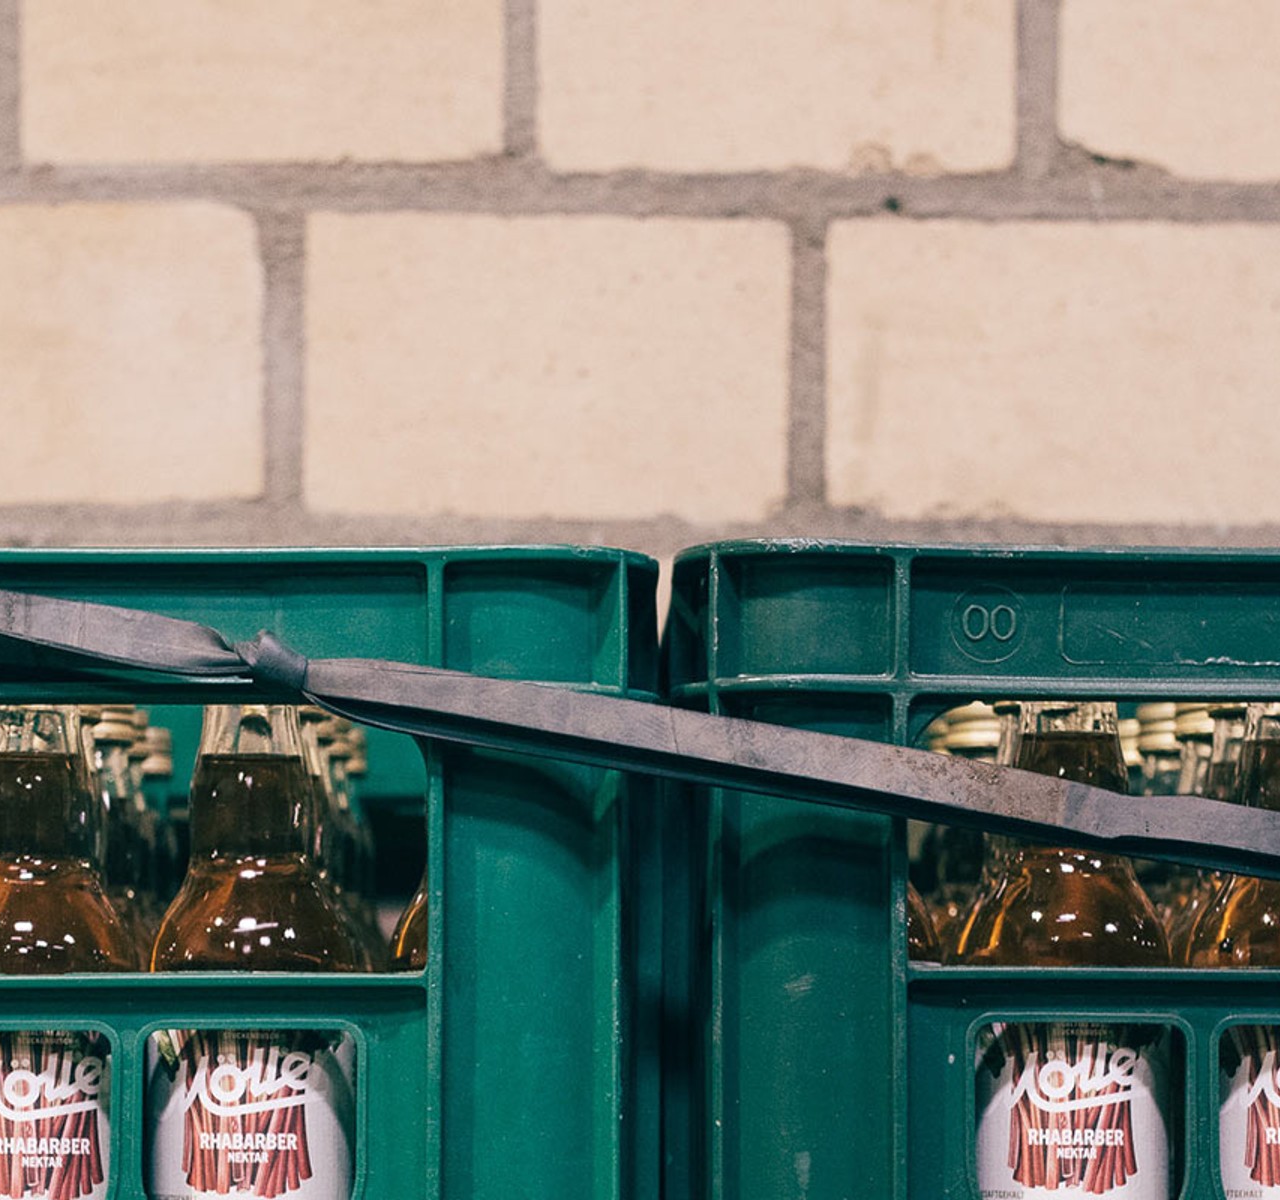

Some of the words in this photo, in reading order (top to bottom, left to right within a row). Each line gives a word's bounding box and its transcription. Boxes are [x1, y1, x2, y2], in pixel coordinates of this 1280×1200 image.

[963, 605, 1016, 640] 00
[200, 1132, 298, 1150] RHABARBER
[1028, 1129, 1124, 1146] RHABARBER
[228, 1152, 269, 1163] NEKTAR
[1057, 1147, 1096, 1159] NEKTAR
[22, 1156, 62, 1168] NEKTAR
